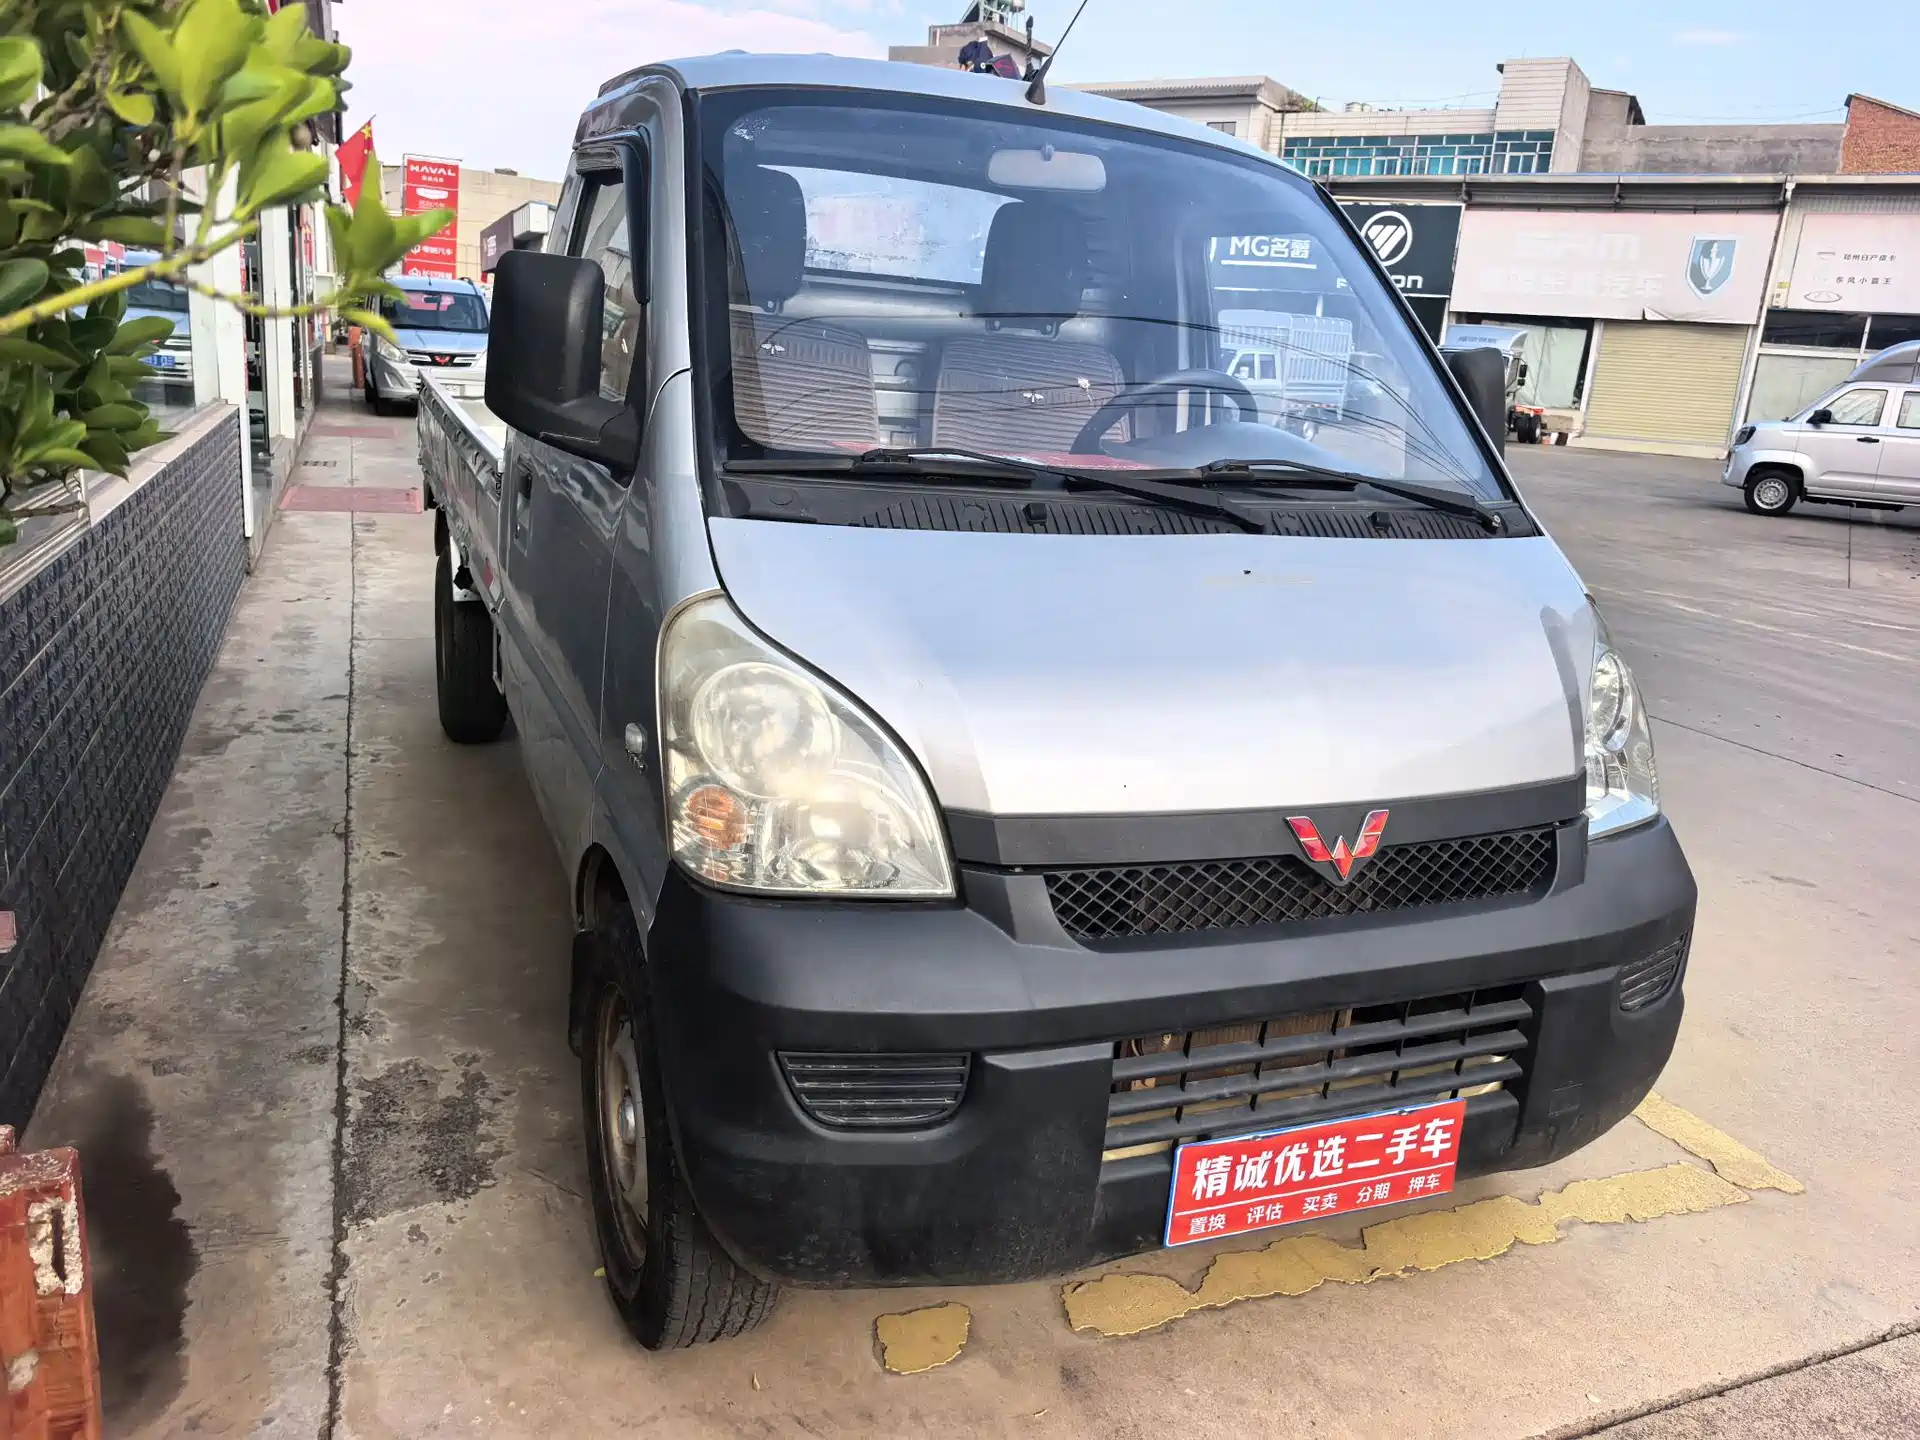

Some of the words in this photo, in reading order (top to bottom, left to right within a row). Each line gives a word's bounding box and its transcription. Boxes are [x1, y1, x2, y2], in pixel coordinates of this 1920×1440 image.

[410, 164, 456, 177] HAVAL
[1843, 253, 1896, 262] 郑州日产皮卡
[1835, 276, 1892, 285] 东风小霸王
[1191, 1117, 1456, 1201] 精诚优选二手车
[1188, 1214, 1226, 1236] 置换
[1246, 1204, 1283, 1225] 评估
[1302, 1192, 1338, 1214] 买卖
[1355, 1181, 1391, 1203] 分期
[1407, 1173, 1441, 1194] 押车
